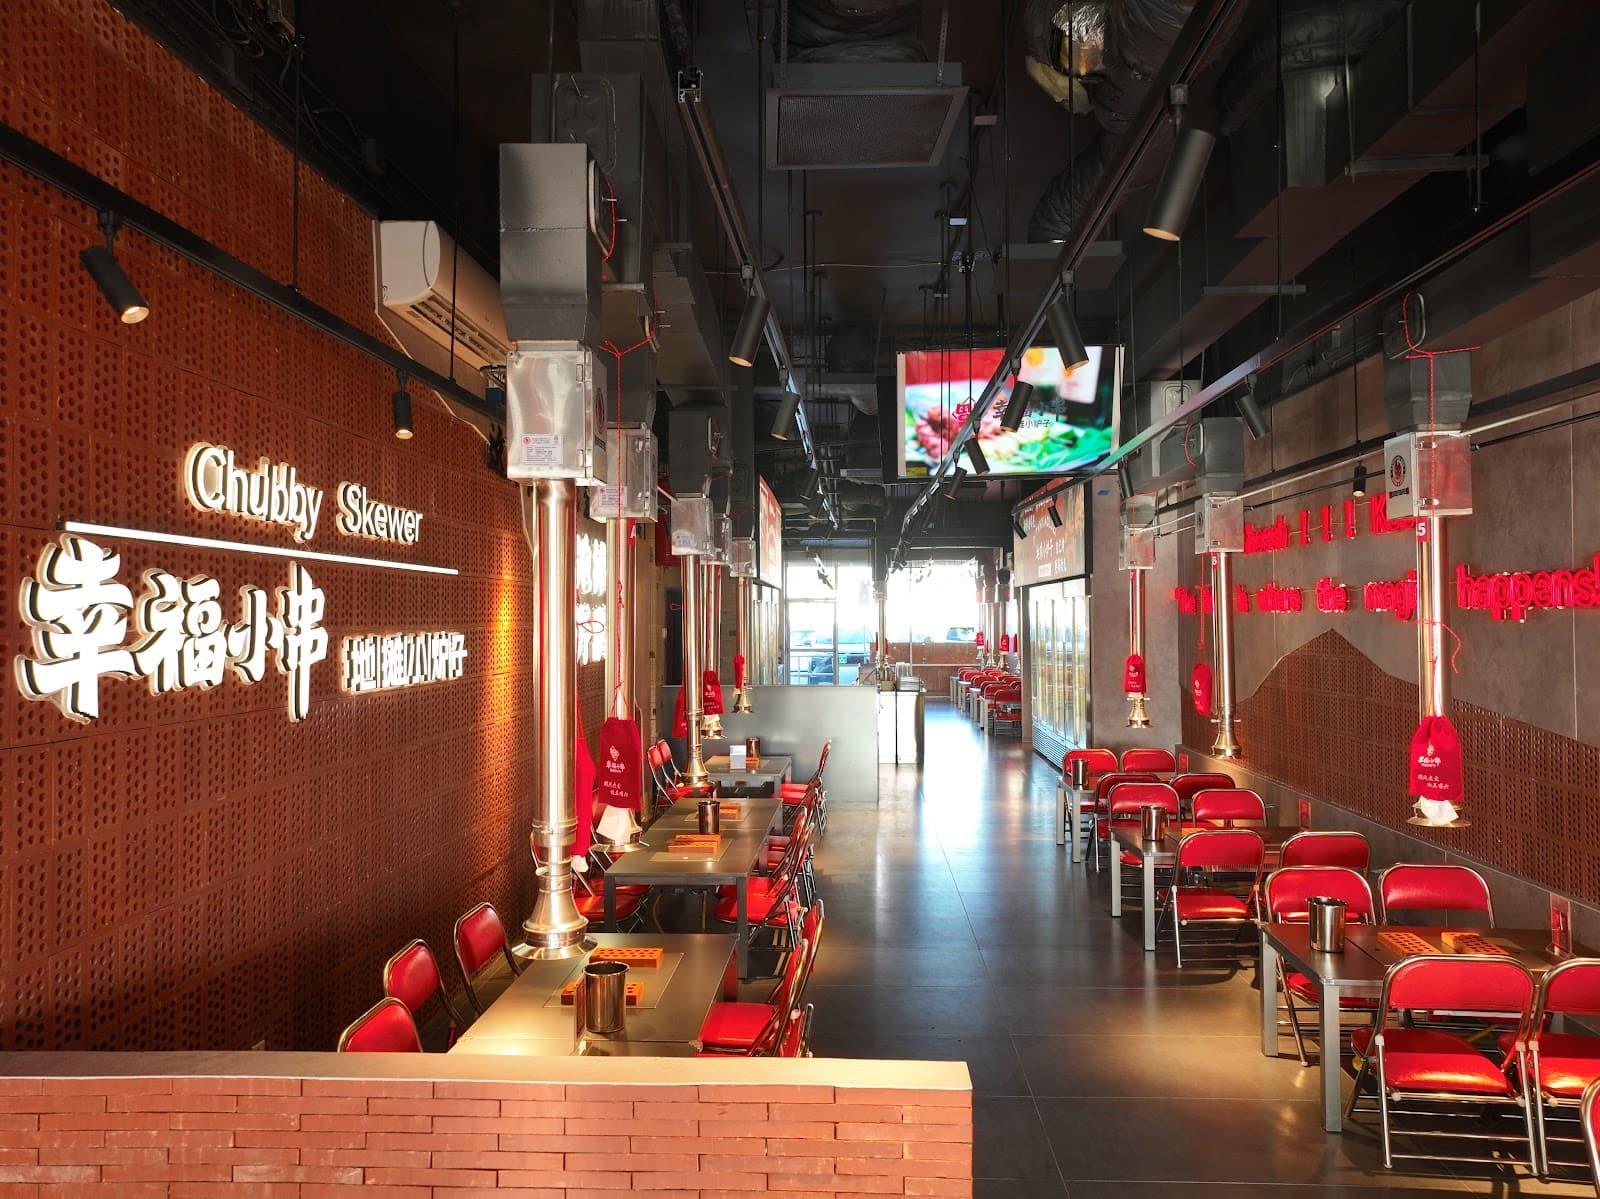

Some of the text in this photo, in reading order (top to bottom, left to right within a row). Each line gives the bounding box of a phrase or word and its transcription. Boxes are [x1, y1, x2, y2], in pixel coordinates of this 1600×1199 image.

[184, 442, 423, 545] Chubby Skewer
[16, 533, 328, 723] 幸福小串
